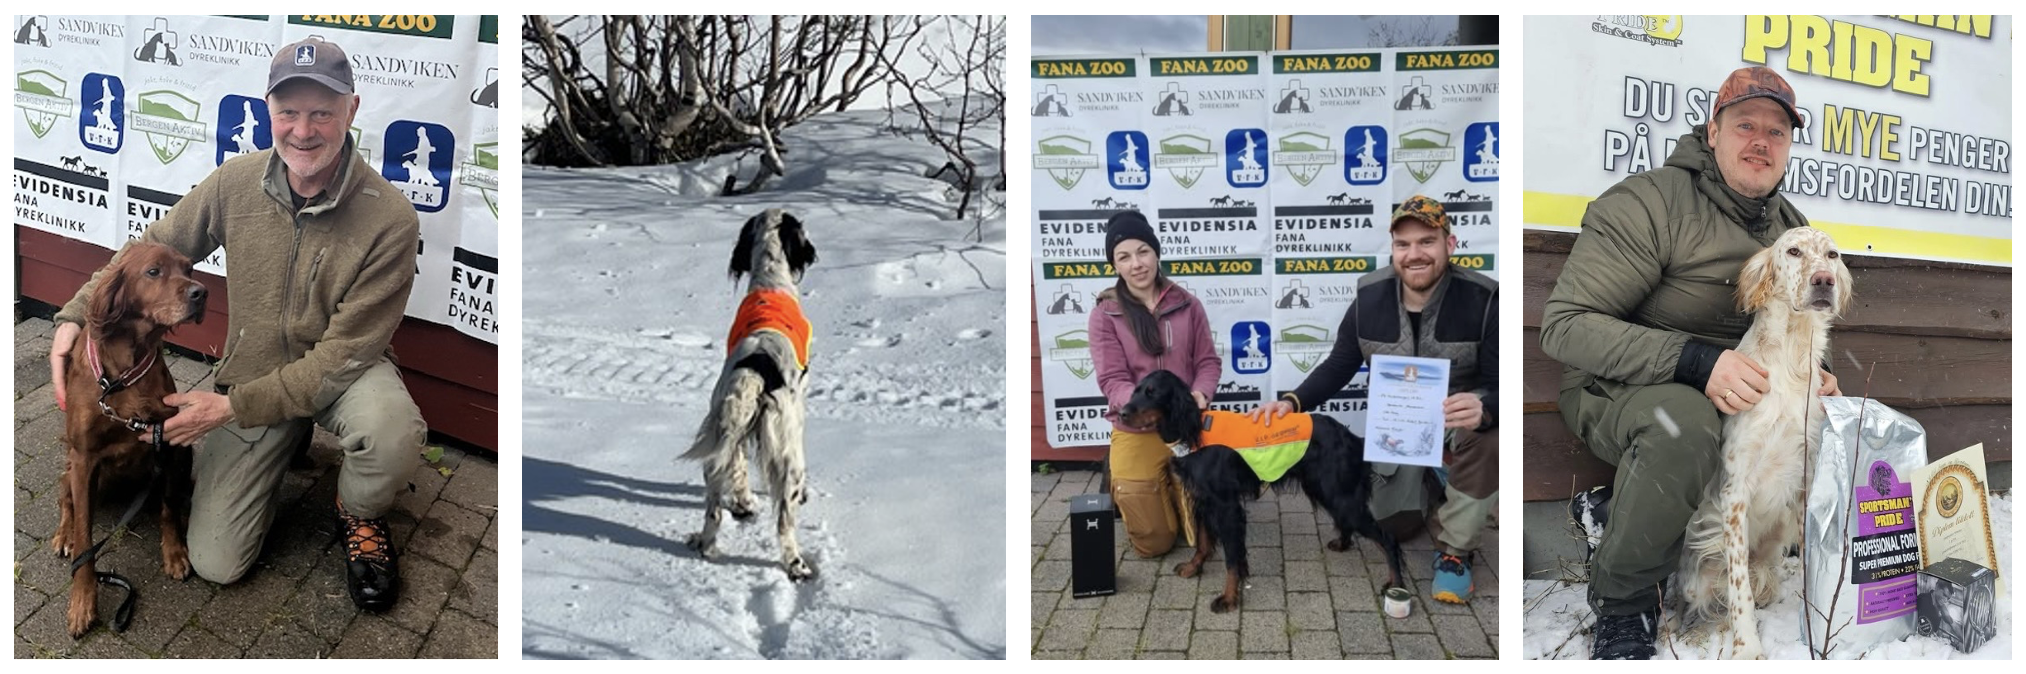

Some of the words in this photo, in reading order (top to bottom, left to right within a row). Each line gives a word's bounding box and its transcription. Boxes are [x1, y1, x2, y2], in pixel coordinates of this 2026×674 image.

[58, 17, 124, 38] SANDVIKEN
[1593, 23, 1612, 35] Skin
[1614, 28, 1622, 37] &
[1625, 30, 1645, 42] Coat
[58, 33, 100, 46] DYREKLINIKK
[189, 34, 274, 58] SANDVIKEN
[189, 52, 240, 66] DYREKLINIKK
[1283, 57, 1331, 71] FANA
[1335, 56, 1371, 70] ZOO
[1406, 55, 1454, 68] FANA
[1458, 53, 1495, 67] ZOO
[1742, 15, 1933, 98] PRIDE
[352, 54, 459, 80] SANDVIKEN
[1038, 62, 1087, 76] FANA
[1089, 61, 1126, 75] ZOO
[1161, 60, 1209, 74] FANA
[1212, 59, 1248, 73] ZOO
[352, 73, 414, 88] DYREKLINIKK
[1198, 89, 1265, 101] SANDVIKEN
[1320, 86, 1386, 98] SANDVIKEN
[1441, 83, 1498, 94] SANDVIKE
[1077, 92, 1144, 103] SANDVIKEN
[136, 116, 170, 131] BERGEN
[1624, 75, 1675, 123] DU
[1822, 103, 1902, 162] MYE
[1909, 126, 2010, 173] PENGER
[1603, 122, 1653, 174] PÅ
[1779, 156, 1958, 212] MSFORDELEN
[468, 168, 498, 185] BERG
[14, 193, 38, 207] ANA
[14, 206, 85, 233] YREKLINIKK
[1159, 219, 1257, 232] EVIDENSIA
[1275, 218, 1373, 230] EVIDENSIA
[1040, 222, 1108, 234] EVIDEN
[1042, 237, 1073, 246] FANA
[1160, 236, 1190, 244] FANA
[1276, 233, 1306, 242] FANA
[1042, 248, 1105, 257] DYREKLINI
[1160, 245, 1237, 255] DYREKLINIKK
[1276, 243, 1352, 252] DYREKLINIKK
[1053, 265, 1101, 277] FANA
[1170, 262, 1216, 274] FANA
[1219, 261, 1253, 273] ZOO
[1285, 260, 1330, 272] FANA
[1333, 258, 1367, 271] ZOO
[1205, 287, 1268, 298] SANDVIKEN
[1319, 285, 1355, 296] SANDV
[450, 287, 493, 315] FANA
[1055, 408, 1108, 421] EVIDE
[1057, 423, 1087, 432] FANA
[1058, 431, 1113, 442] DYREKLIN
[1875, 512, 1904, 528] PRIDE
[1853, 535, 1900, 558] PROFESSIONAL
[1859, 560, 1877, 571] SUPER
[1878, 555, 1902, 568] PREMIUM
[1903, 552, 1916, 563] DOG
